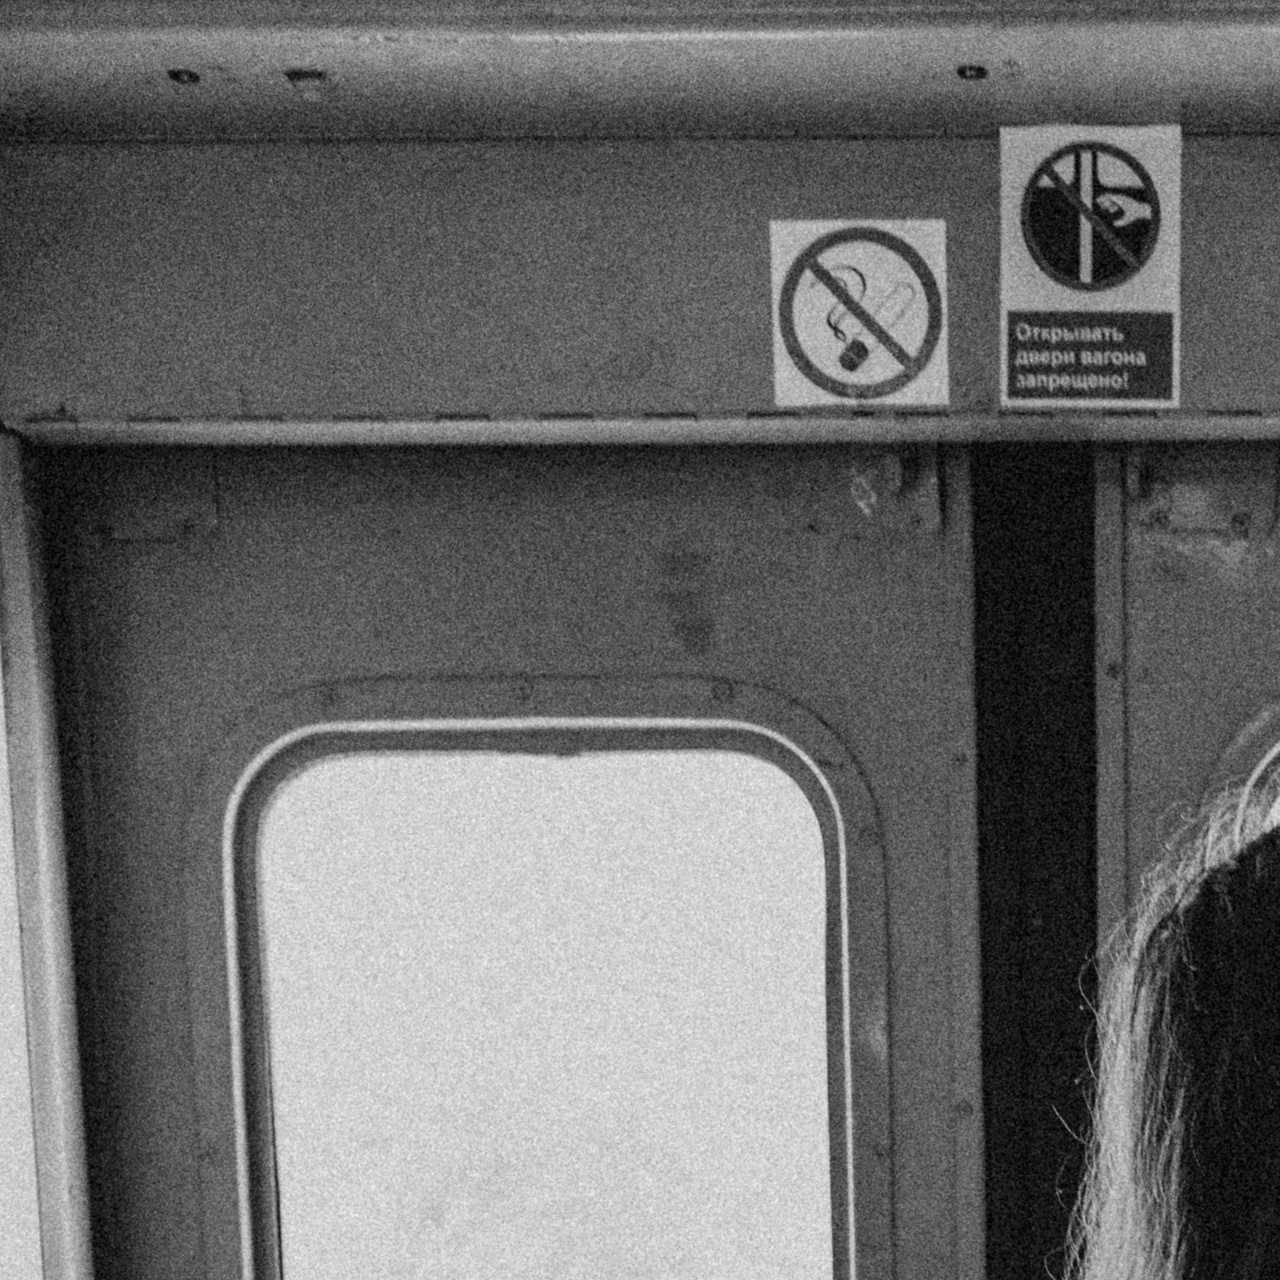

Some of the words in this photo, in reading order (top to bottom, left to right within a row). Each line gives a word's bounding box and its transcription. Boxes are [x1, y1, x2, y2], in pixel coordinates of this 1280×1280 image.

[1015, 322, 1125, 344] Открывать
[1015, 350, 1076, 368] двери
[1080, 350, 1147, 366] вагона
[1015, 371, 1130, 391] запрещено!
